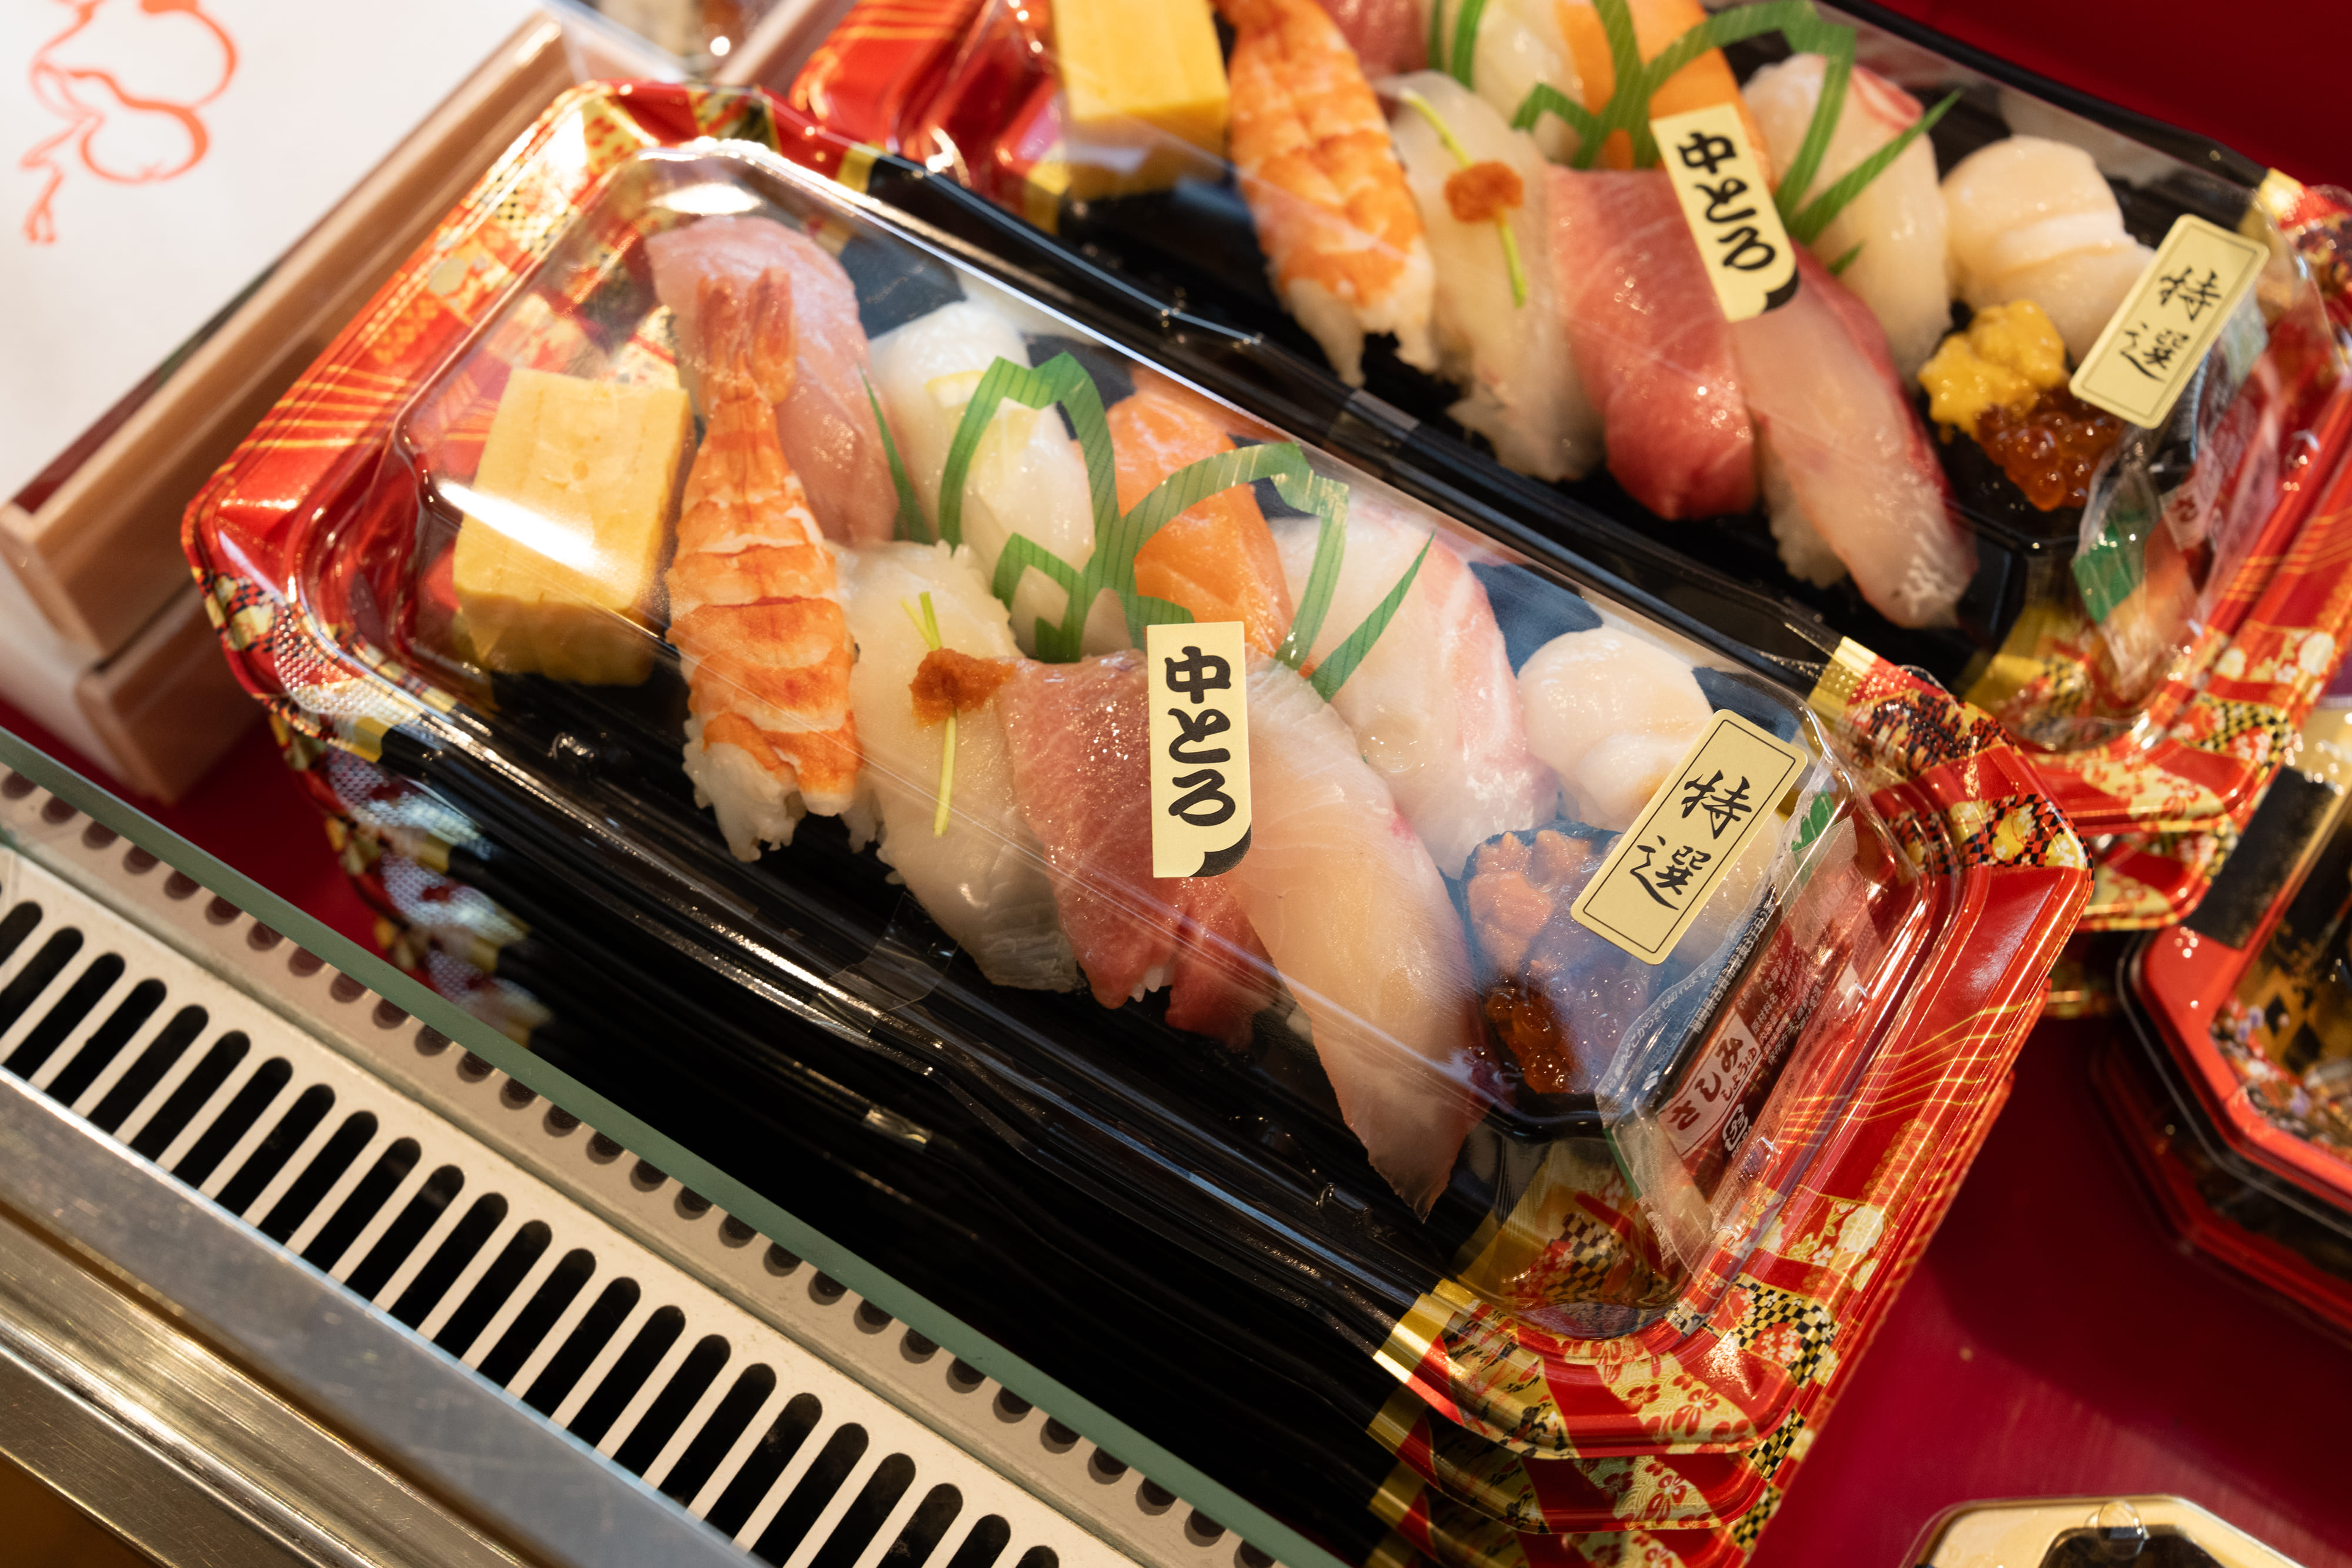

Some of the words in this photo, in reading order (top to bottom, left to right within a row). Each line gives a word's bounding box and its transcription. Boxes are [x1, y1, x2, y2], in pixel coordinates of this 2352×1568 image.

[1677, 130, 1776, 272] 中とろ
[2118, 265, 2222, 383] 特選
[1164, 645, 1236, 827] 中とろ
[1629, 769, 1752, 910] 特選
[1666, 1037, 1744, 1131] さしみ
[1720, 1047, 1758, 1102] しょうゆ
